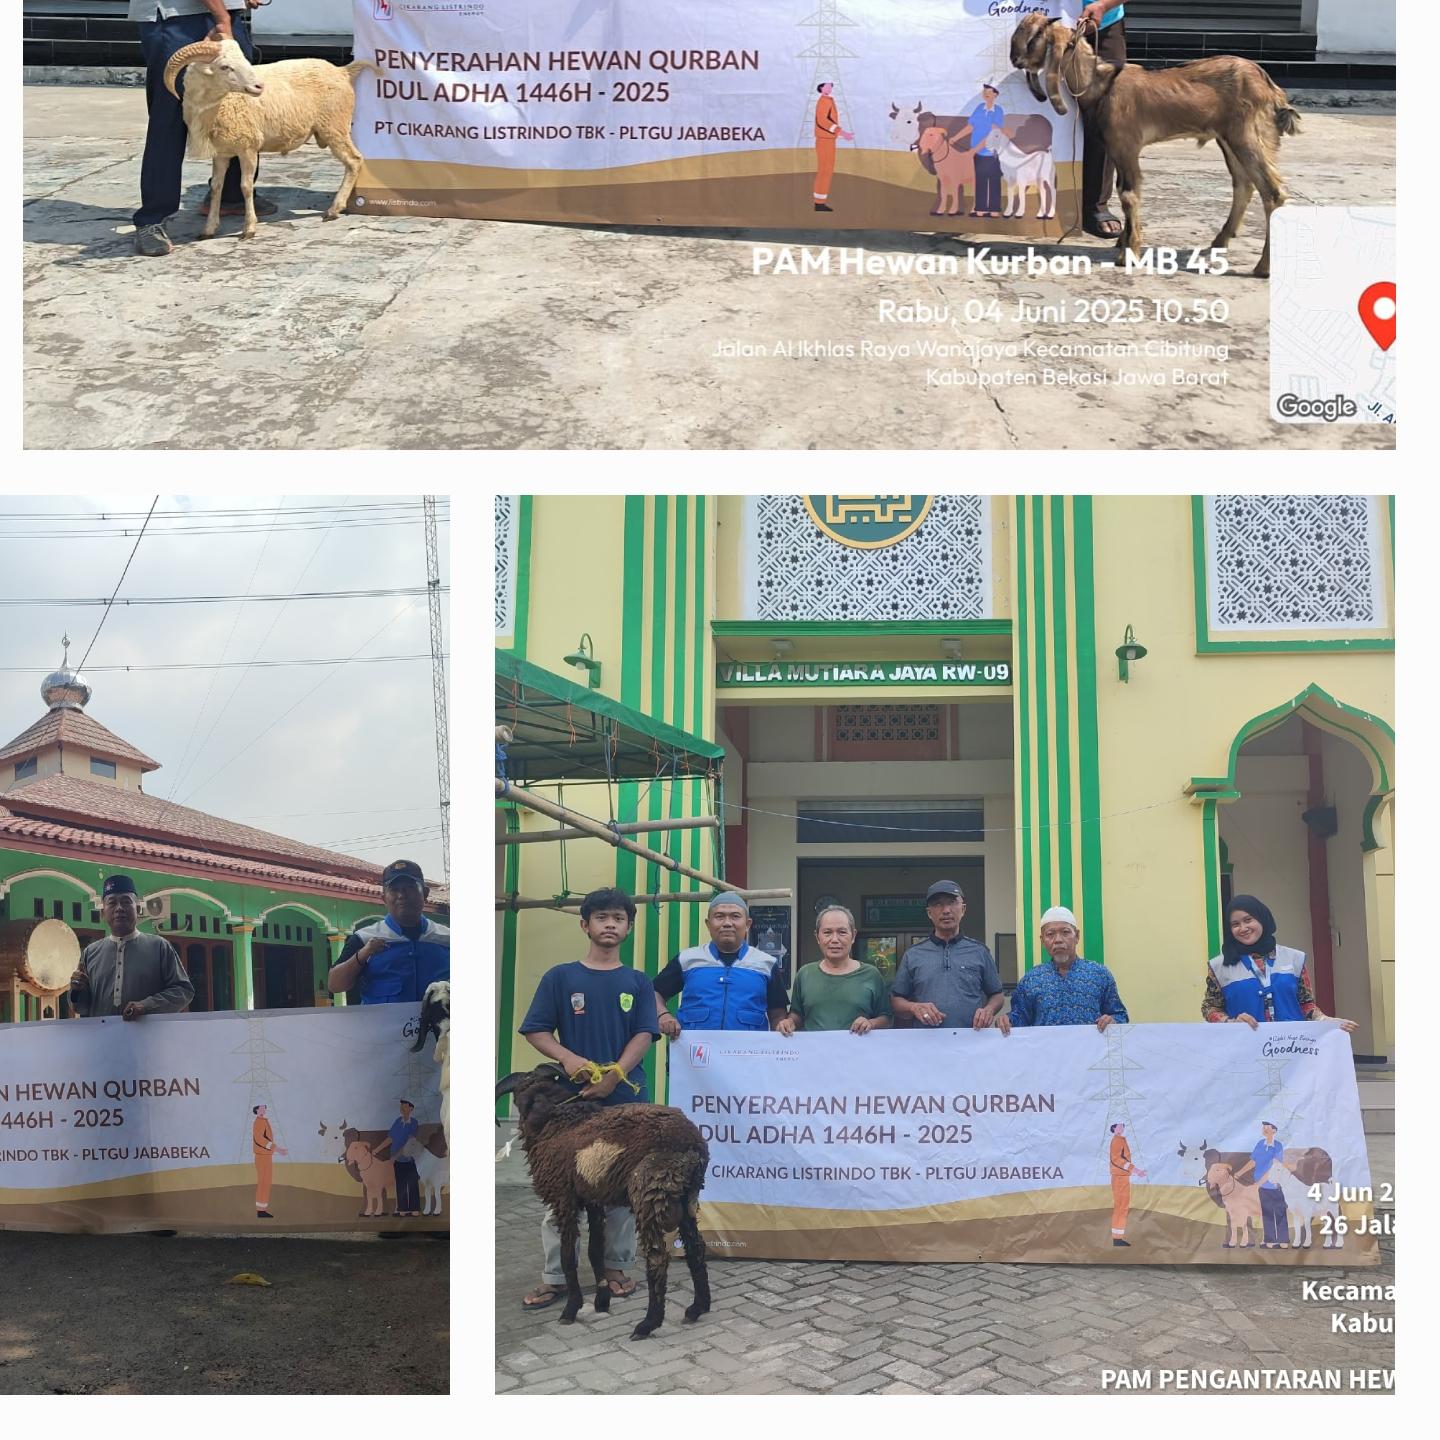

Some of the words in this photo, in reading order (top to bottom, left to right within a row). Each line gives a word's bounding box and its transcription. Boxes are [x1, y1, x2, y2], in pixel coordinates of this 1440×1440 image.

[374, 48, 541, 73] PENYERAHAN
[549, 50, 641, 71] HEWAN
[648, 50, 759, 74] QURBAN
[376, 79, 429, 101] IDUL
[433, 82, 508, 103] ADHA
[517, 82, 592, 103] 1446H
[612, 81, 670, 103] 2025
[375, 121, 394, 135] PT
[397, 122, 479, 139] CIKARANG
[483, 126, 572, 140] LISTRINDO
[576, 126, 605, 139] TBK
[619, 126, 673, 140] PLTGU
[677, 126, 766, 142] JABABEKA
[720, 664, 782, 681] VILLA
[787, 664, 885, 681] MUTIARA
[889, 664, 937, 680] JAYA
[942, 663, 1009, 680] RW-09
[1262, 1040, 1320, 1058] Goodness
[15, 1080, 97, 1102] HEWAN
[103, 1077, 200, 1100] QURBAN
[692, 1094, 847, 1115] PENYERAHAN
[855, 1095, 945, 1115] HEWAN
[953, 1093, 1055, 1116] QURBAN
[73, 1107, 124, 1128] 2025
[699, 1124, 741, 1144] DUL
[747, 1125, 815, 1144] ADHA
[823, 1125, 895, 1144] 1446H
[918, 1124, 973, 1144] 2025
[41, 1148, 70, 1161] TBK
[83, 1146, 130, 1161] PLTGU
[133, 1145, 210, 1160] JABABEKA
[712, 1165, 788, 1180] CIKARANG
[792, 1167, 875, 1181] LISTRINDO
[880, 1167, 911, 1180] TBK
[926, 1166, 976, 1180] PLTGU
[981, 1166, 1063, 1180] JABABEKA
